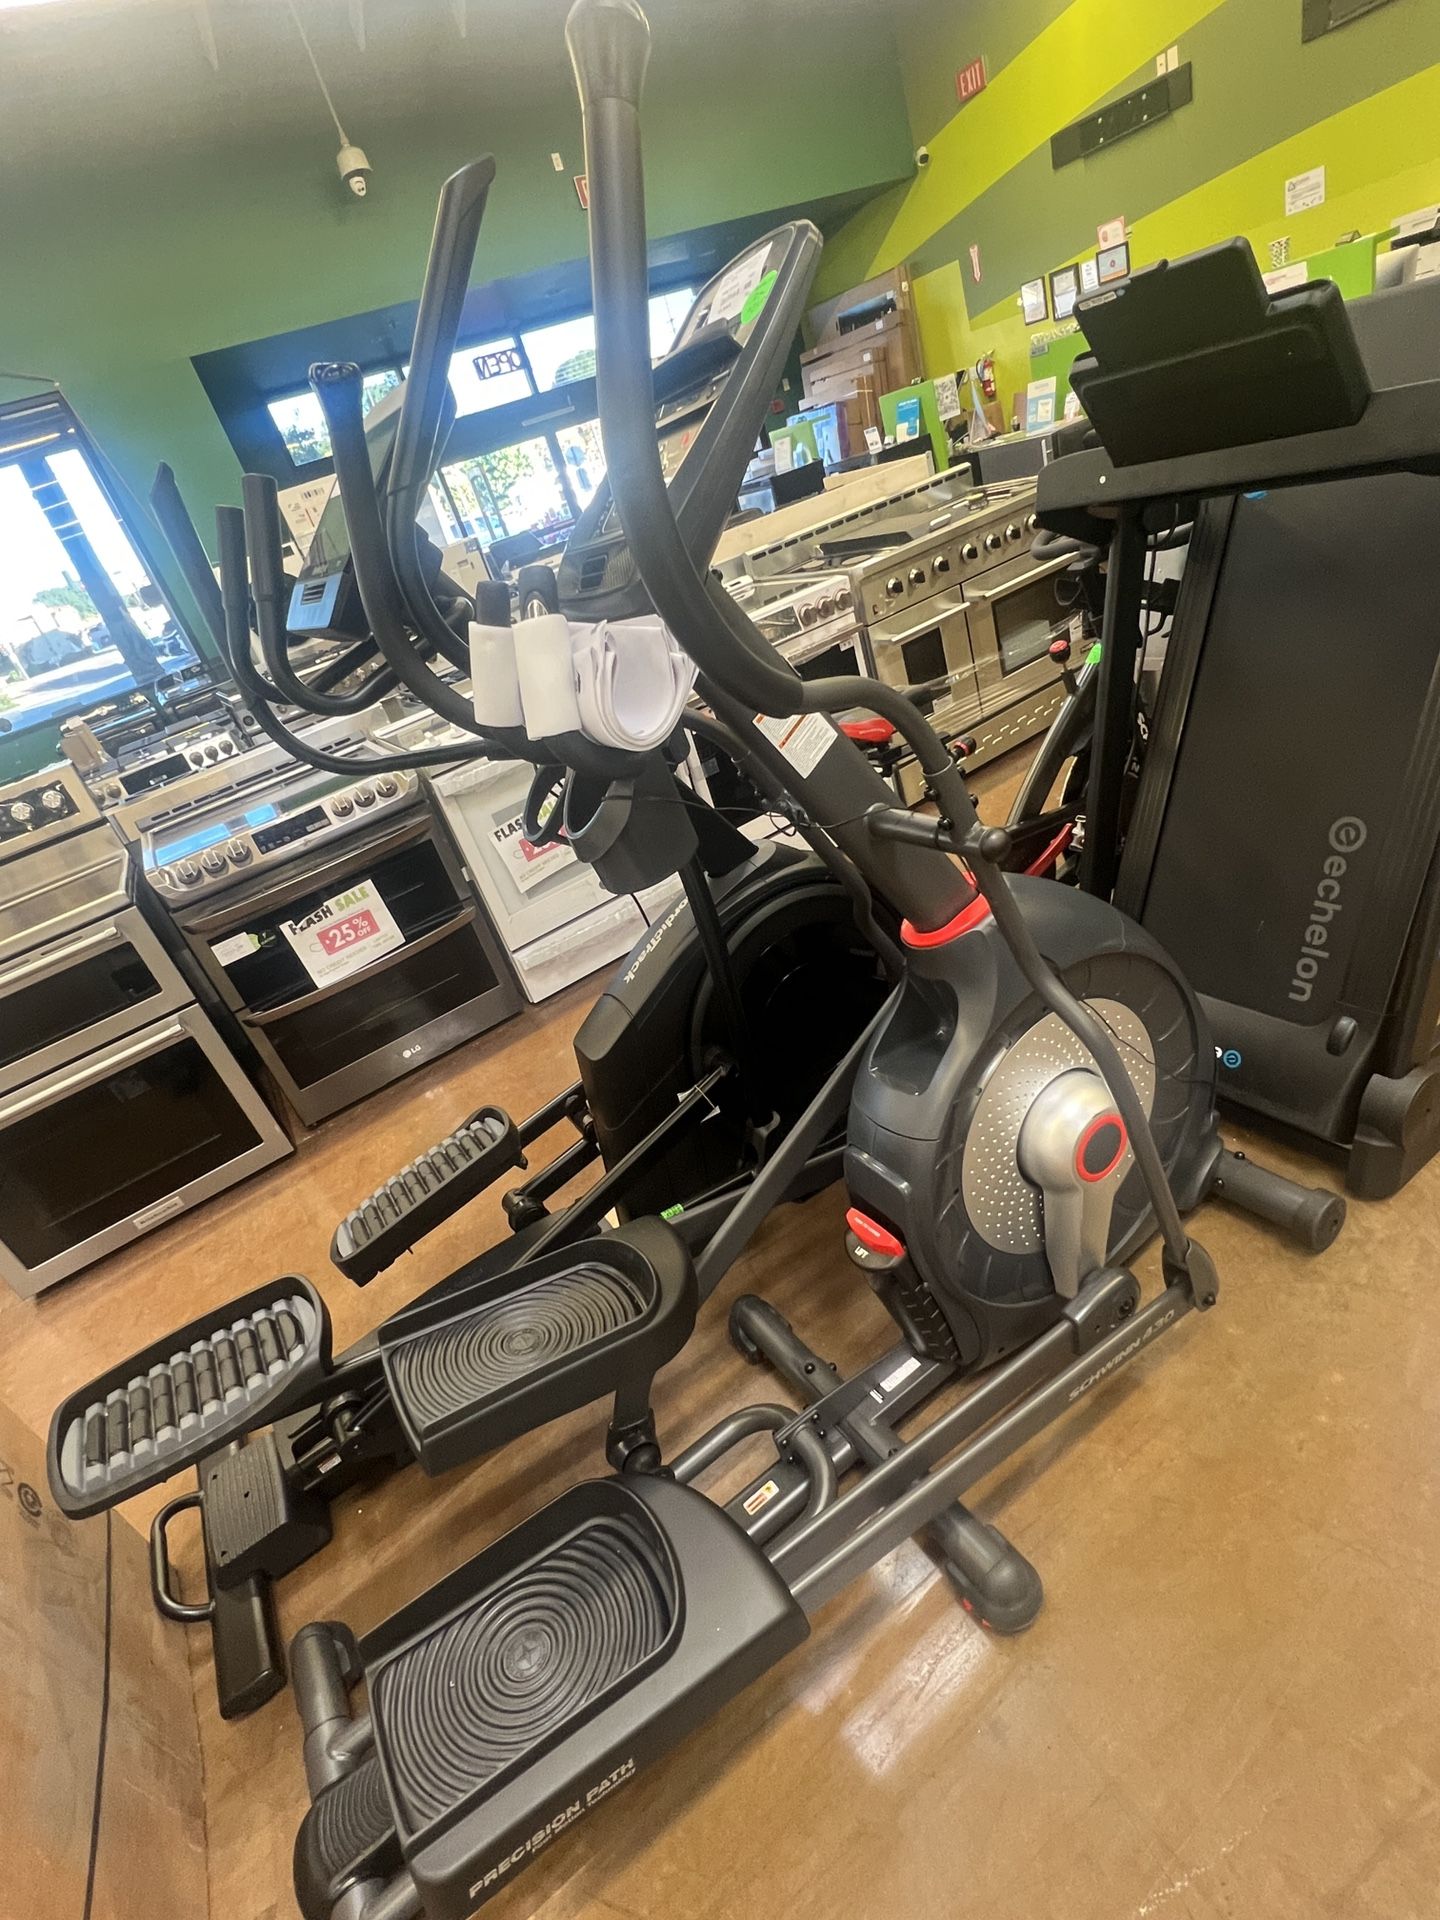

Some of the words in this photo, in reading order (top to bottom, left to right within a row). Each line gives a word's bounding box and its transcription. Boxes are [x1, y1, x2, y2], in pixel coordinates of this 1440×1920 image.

[959, 62, 981, 97] EXIT
[493, 813, 525, 842] FLAS
[334, 886, 370, 912] SALE
[357, 926, 372, 937] OFF
[623, 896, 689, 984] ordicTrack
[1288, 855, 1347, 1001] echelon
[410, 1044, 422, 1054] LG
[1068, 1338, 1141, 1401] SCHWINN
[1142, 1309, 1175, 1340] 430
[469, 1800, 581, 1899] PRECISION
[586, 1758, 635, 1803] PATH
